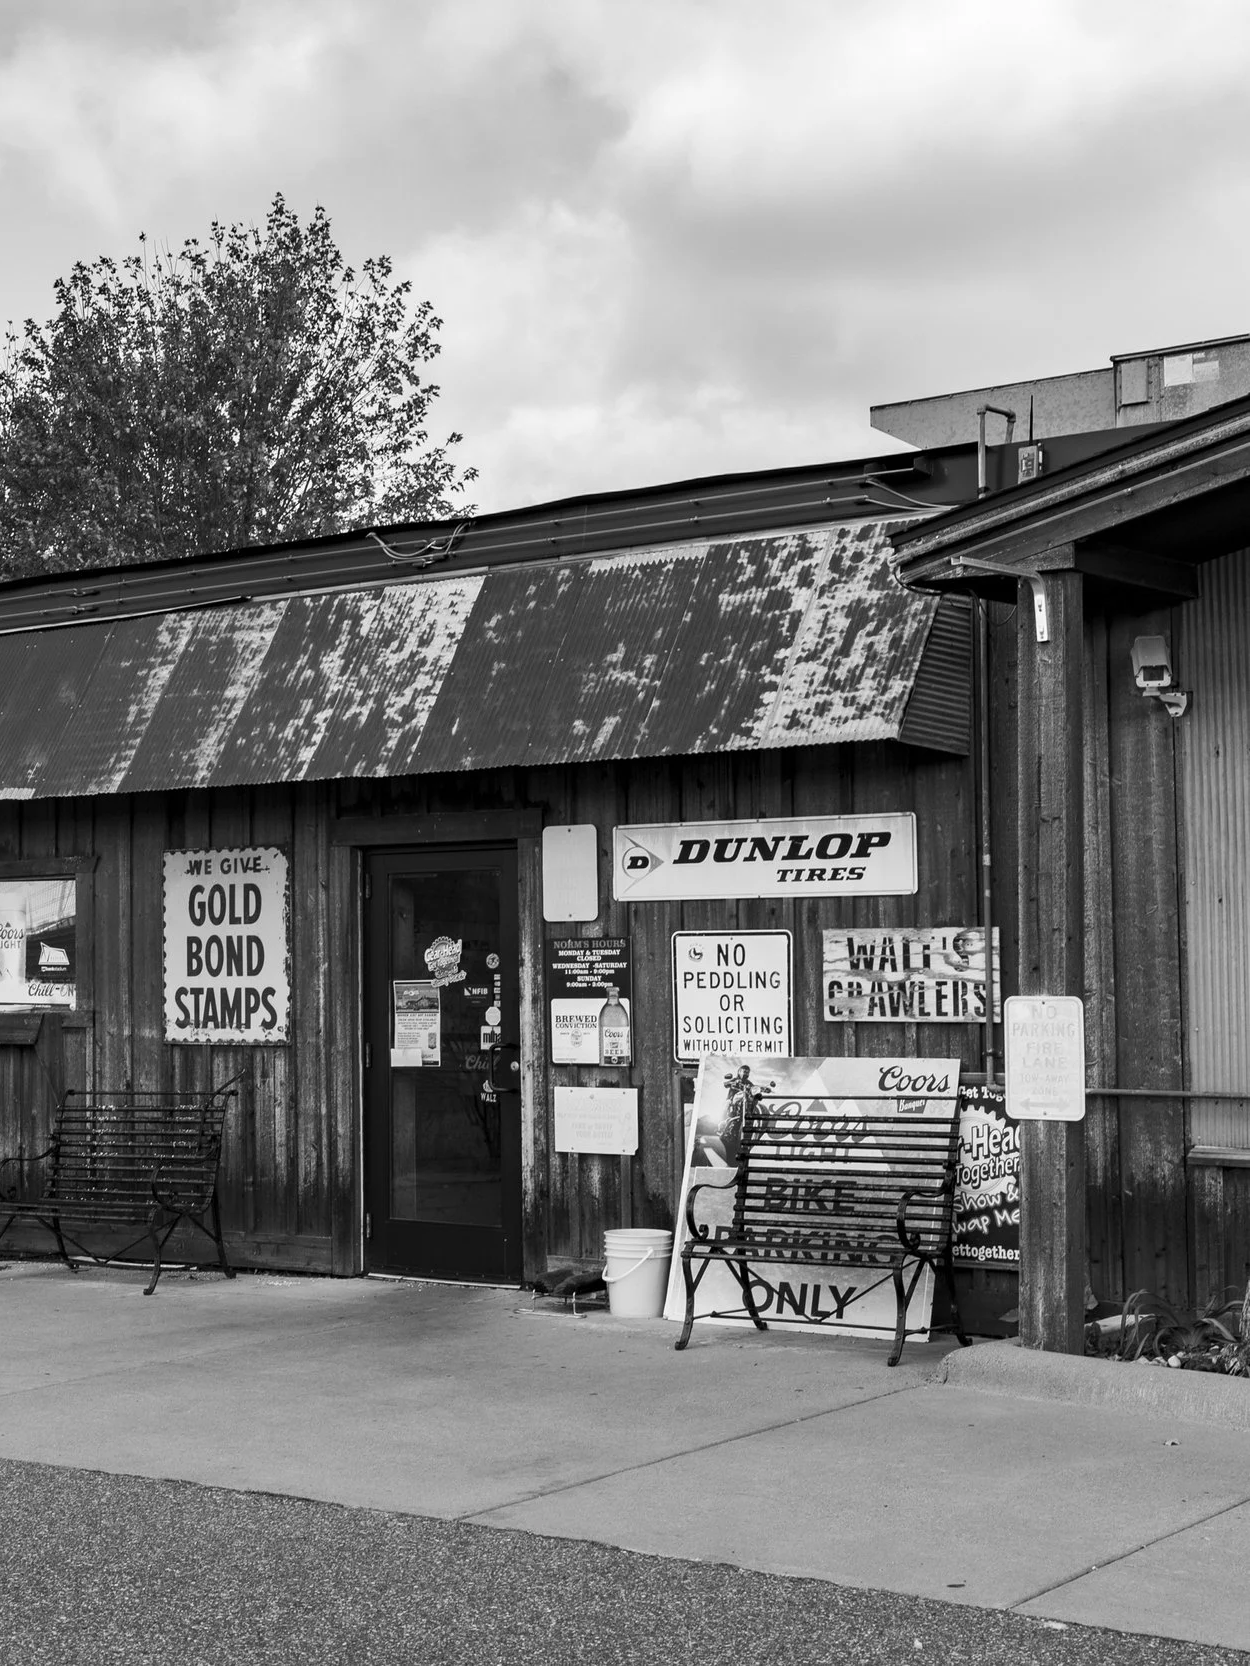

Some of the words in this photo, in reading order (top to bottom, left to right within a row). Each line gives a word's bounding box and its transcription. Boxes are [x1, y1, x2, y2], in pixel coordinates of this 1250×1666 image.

[673, 831, 891, 864] DUNLOP
[188, 859, 212, 876] WE
[220, 856, 262, 874] GIVE
[776, 866, 866, 882] TIRES
[188, 883, 262, 926] GOLD
[553, 940, 589, 949] NORM'S
[592, 940, 626, 948] HOURS
[187, 935, 264, 977] BOND
[717, 943, 745, 966] NO
[683, 971, 780, 989] PEDDLING
[175, 986, 277, 1030] STAMPS
[719, 994, 744, 1011] OR
[555, 1015, 597, 1023] BREWED
[1031, 1005, 1057, 1019] NO
[604, 1029, 624, 1038] Coors
[683, 1016, 782, 1034] SOLICITING
[1012, 1022, 1075, 1037] PARKING
[683, 1039, 733, 1051] WITHOUT
[740, 1040, 784, 1053] PERMIT
[1026, 1042, 1062, 1054] FIRE
[1022, 1057, 1067, 1068] LANE
[878, 1066, 950, 1092] Coors
[981, 1086, 1006, 1102] Tog
[764, 1178, 857, 1211] BIKE
[953, 1192, 1001, 1212] Show
[1007, 1184, 1019, 1202] &
[952, 1215, 990, 1235] wap
[993, 1208, 1020, 1227] Me
[952, 1243, 1020, 1261] ettogether
[742, 1279, 858, 1319] ONLY
